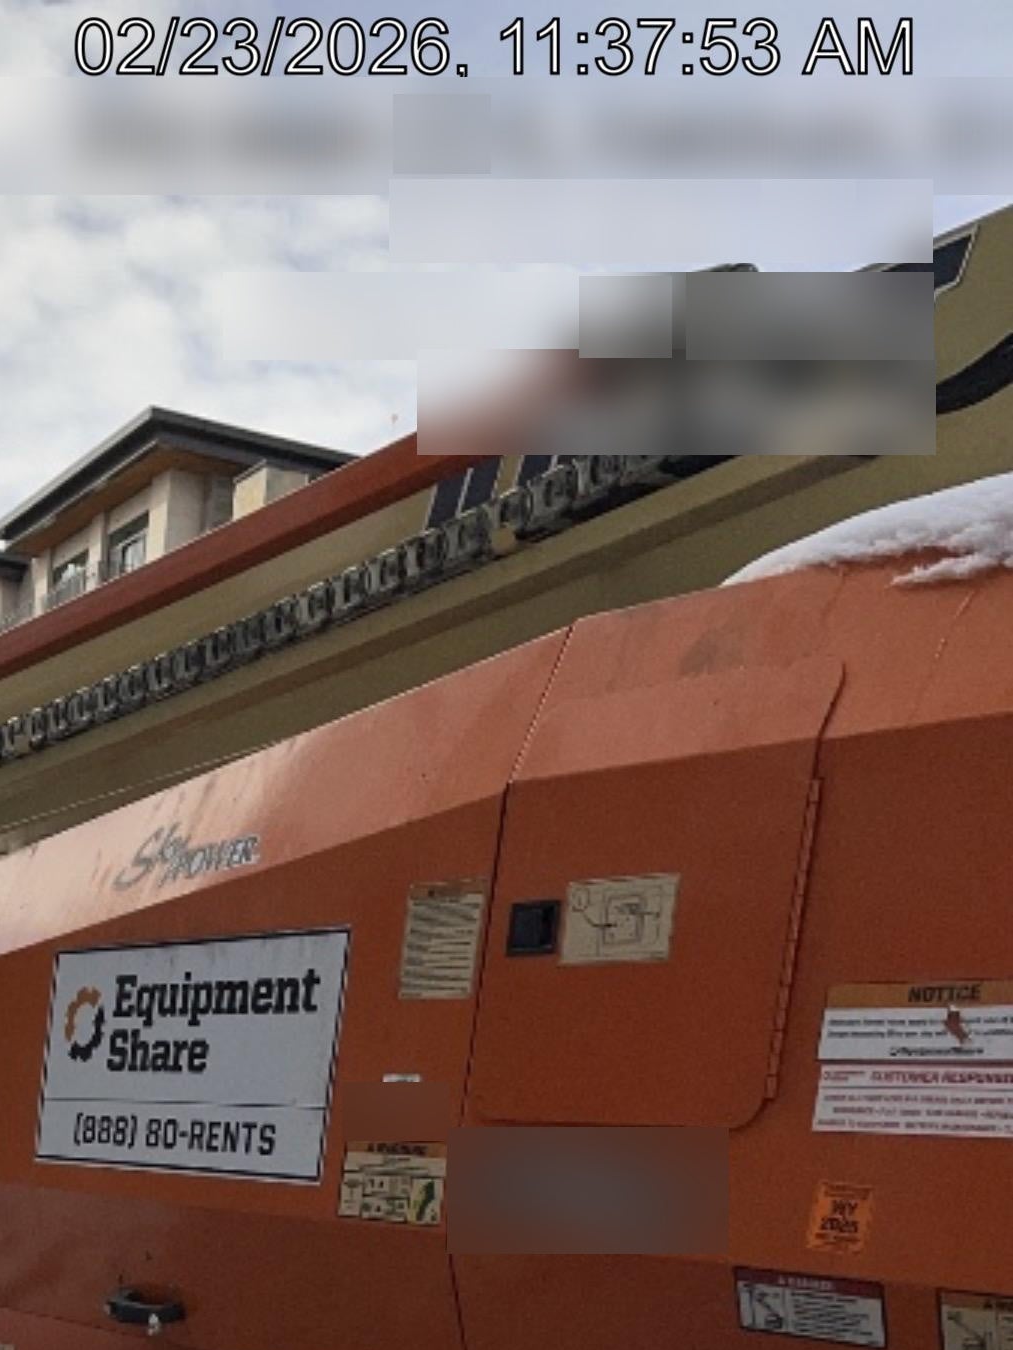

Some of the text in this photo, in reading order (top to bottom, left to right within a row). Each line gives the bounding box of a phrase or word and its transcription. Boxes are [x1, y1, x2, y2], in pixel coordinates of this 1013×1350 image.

[113, 968, 320, 1027] Equipment
[907, 984, 981, 1003] NOTICE
[106, 1029, 209, 1074] Share
[73, 1111, 277, 1156] (888) 80-RENTS
